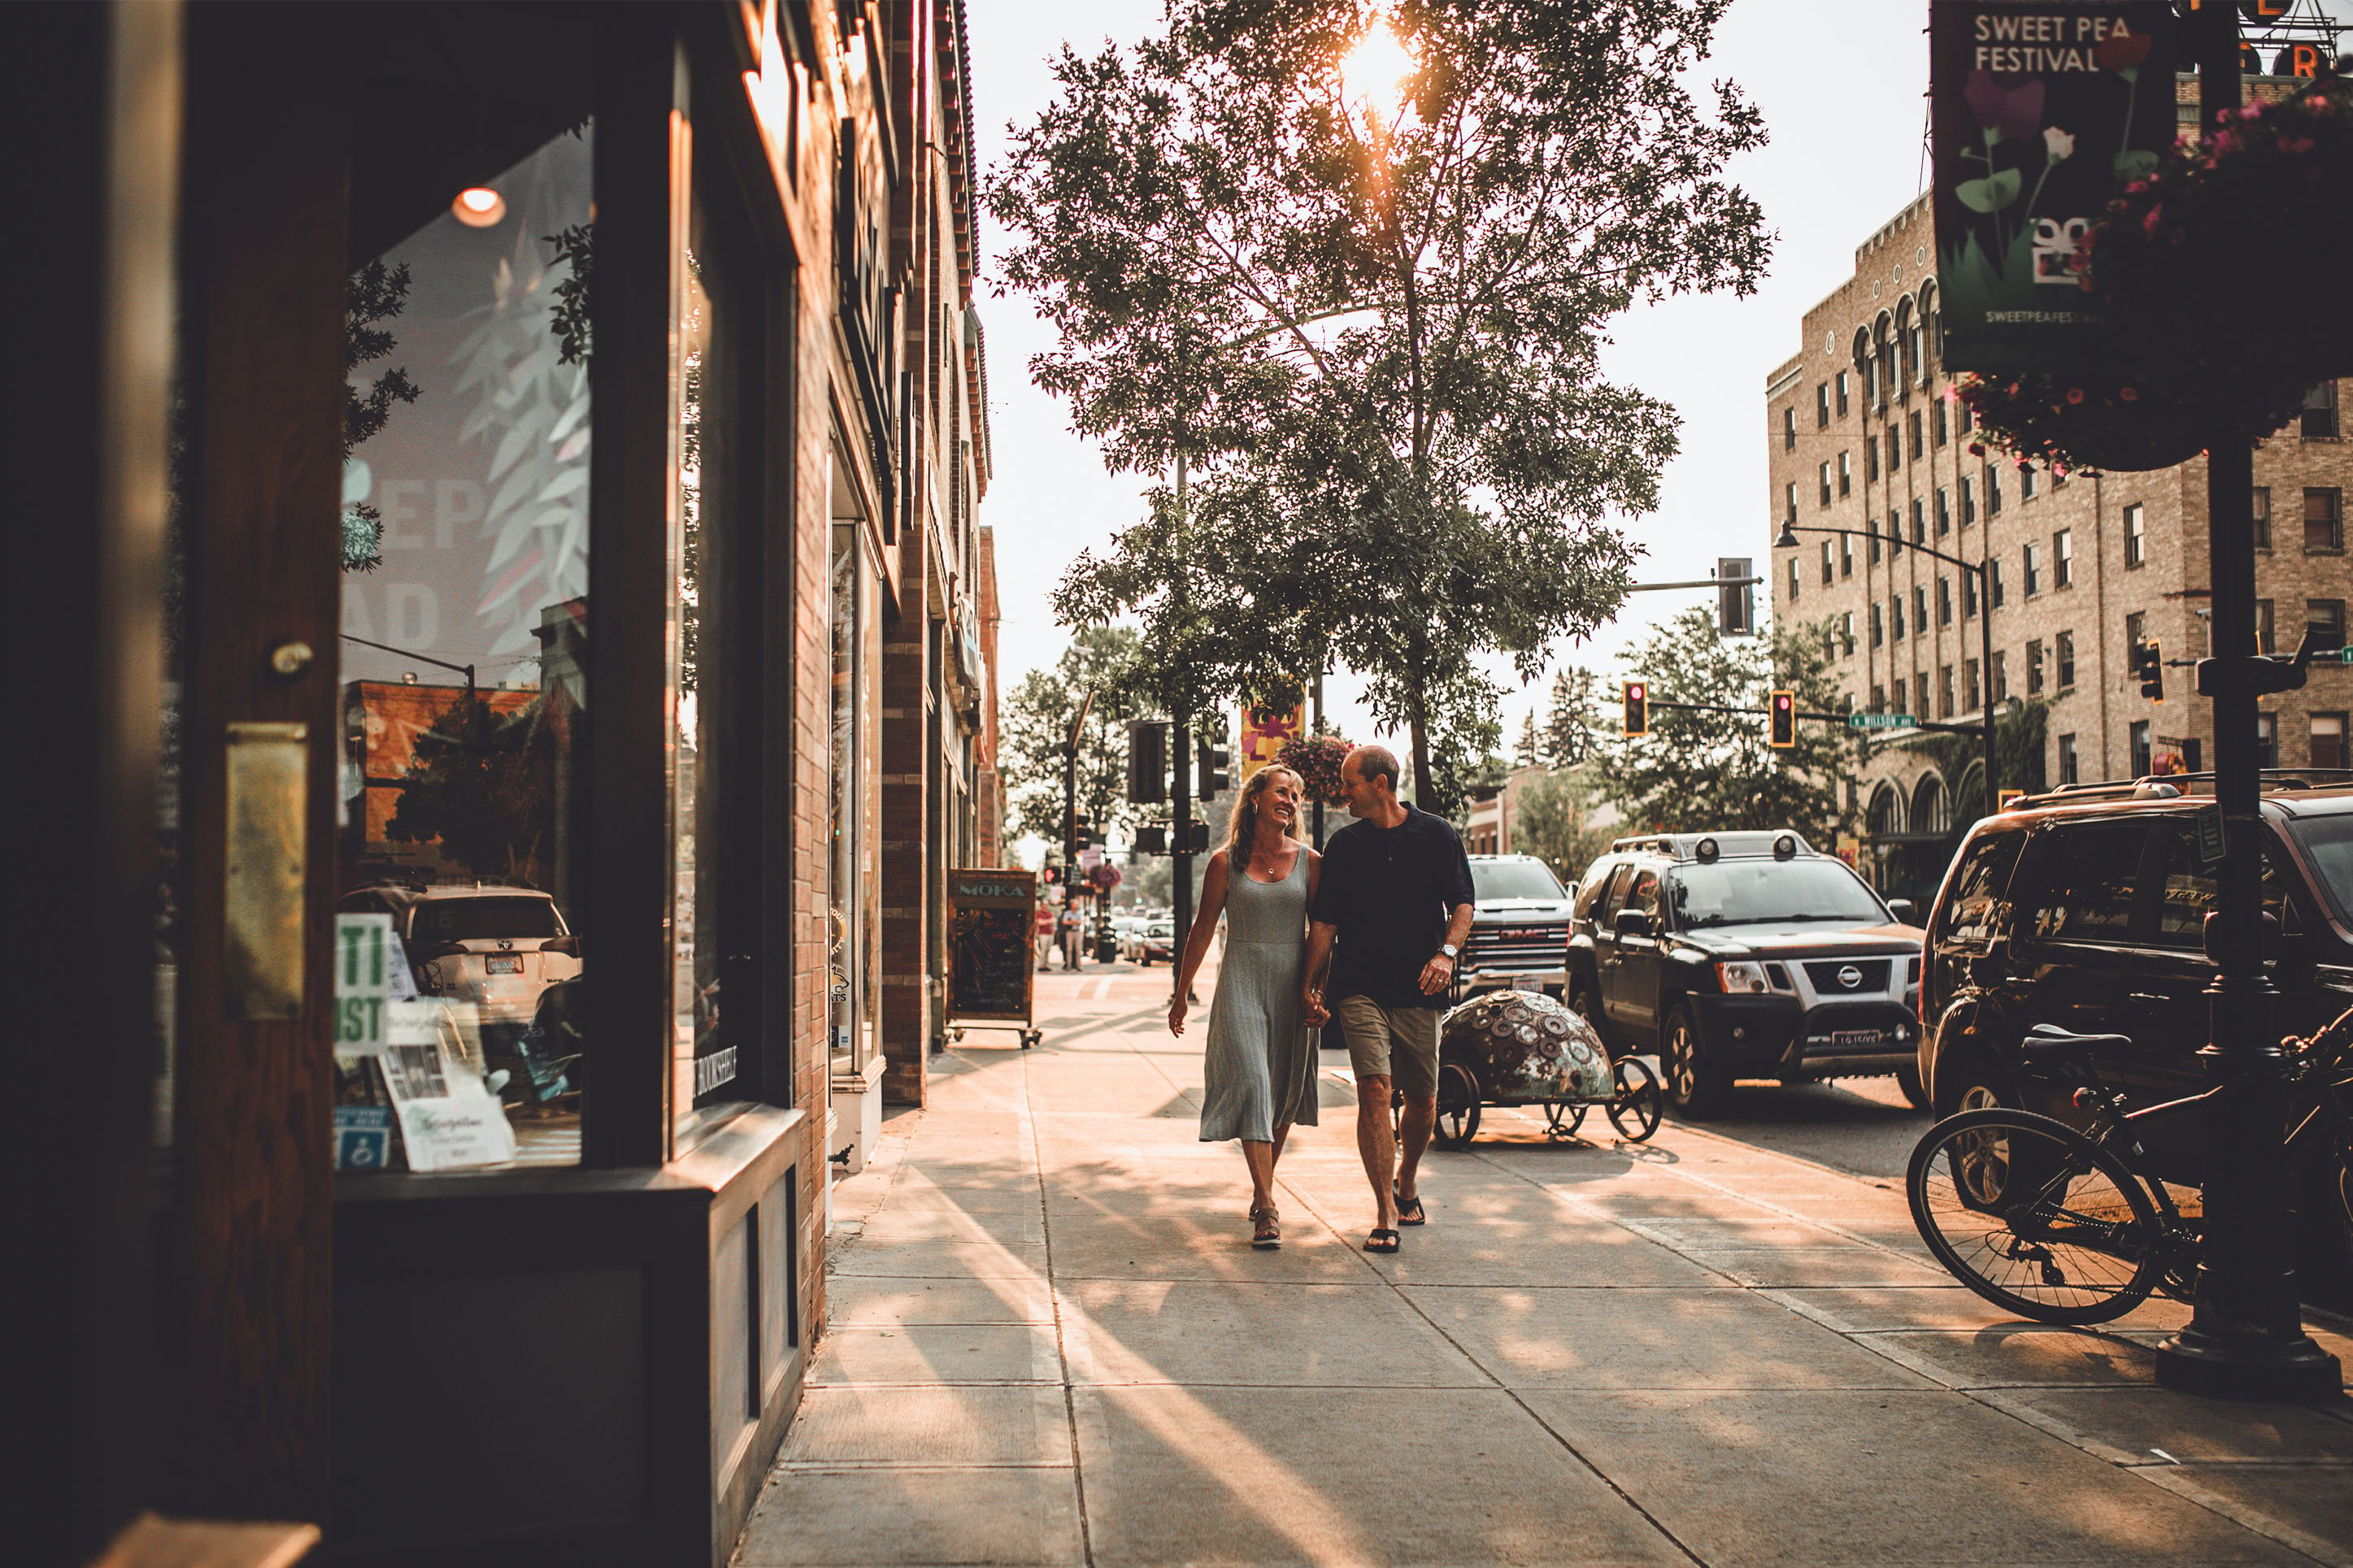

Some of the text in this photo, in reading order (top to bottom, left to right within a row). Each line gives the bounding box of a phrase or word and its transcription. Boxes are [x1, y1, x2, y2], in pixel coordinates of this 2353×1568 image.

[1974, 14, 2131, 42] SWEET PEA
[1975, 46, 2101, 73] FESTIVAL
[1864, 715, 1897, 728] WILLSON
[1900, 718, 1912, 727] AVE
[1499, 928, 1548, 940] GMC
[698, 1045, 737, 1097] BOOKSHELF
